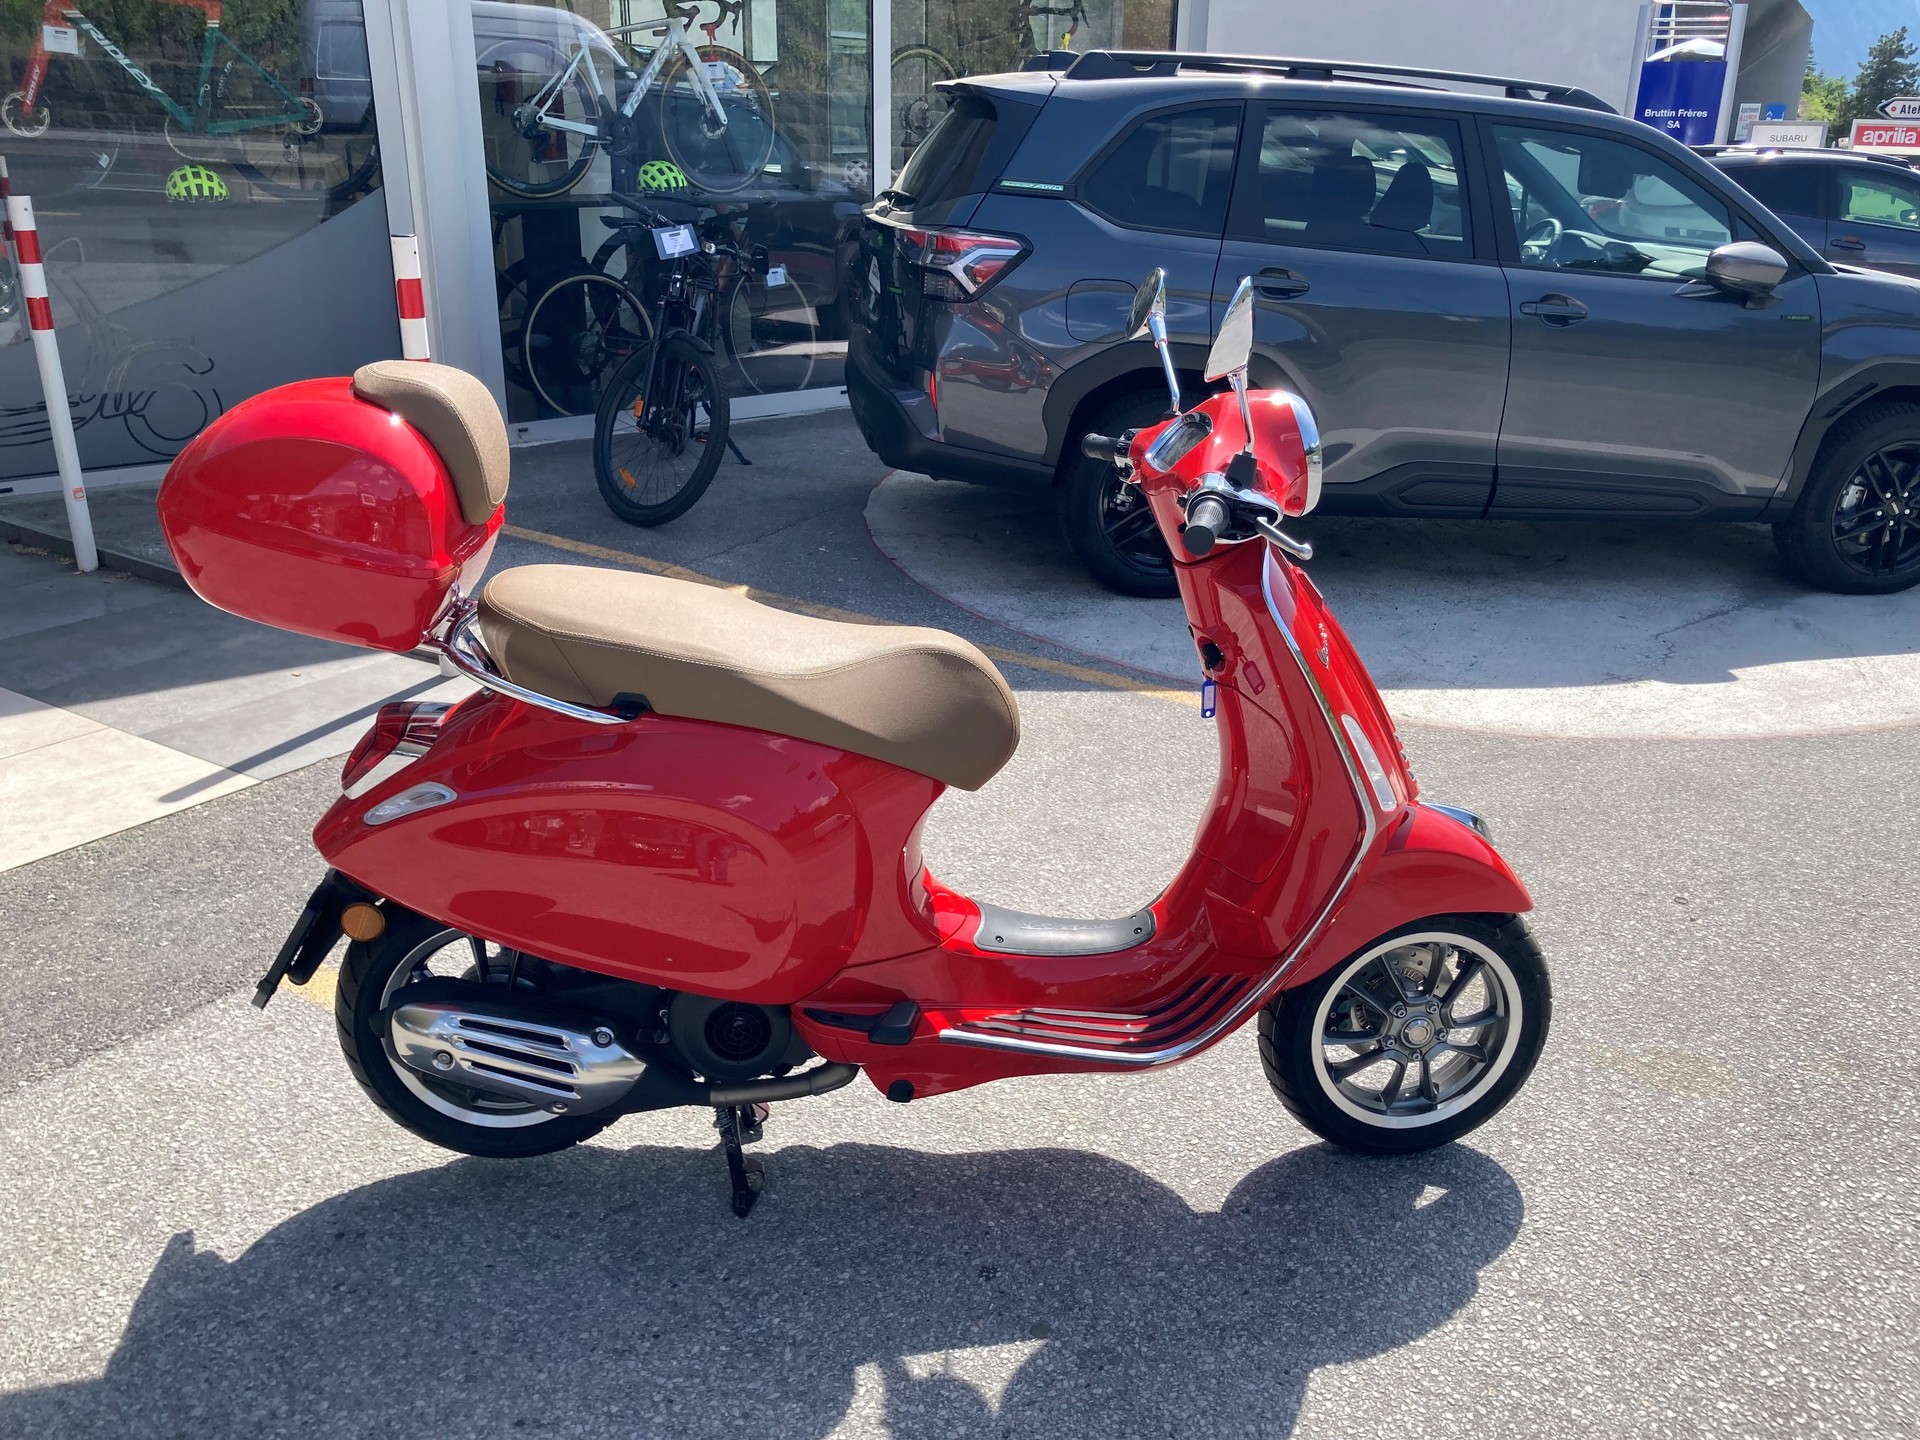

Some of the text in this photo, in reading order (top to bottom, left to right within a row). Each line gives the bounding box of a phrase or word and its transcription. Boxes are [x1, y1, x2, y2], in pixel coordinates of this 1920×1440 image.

[81, 23, 164, 94] RIDLEY
[1644, 108, 1708, 118] Bruttin Frères
[1666, 120, 1680, 129] SA
[1769, 134, 1808, 143] SUBARU
[1861, 127, 1917, 146] aprilia
